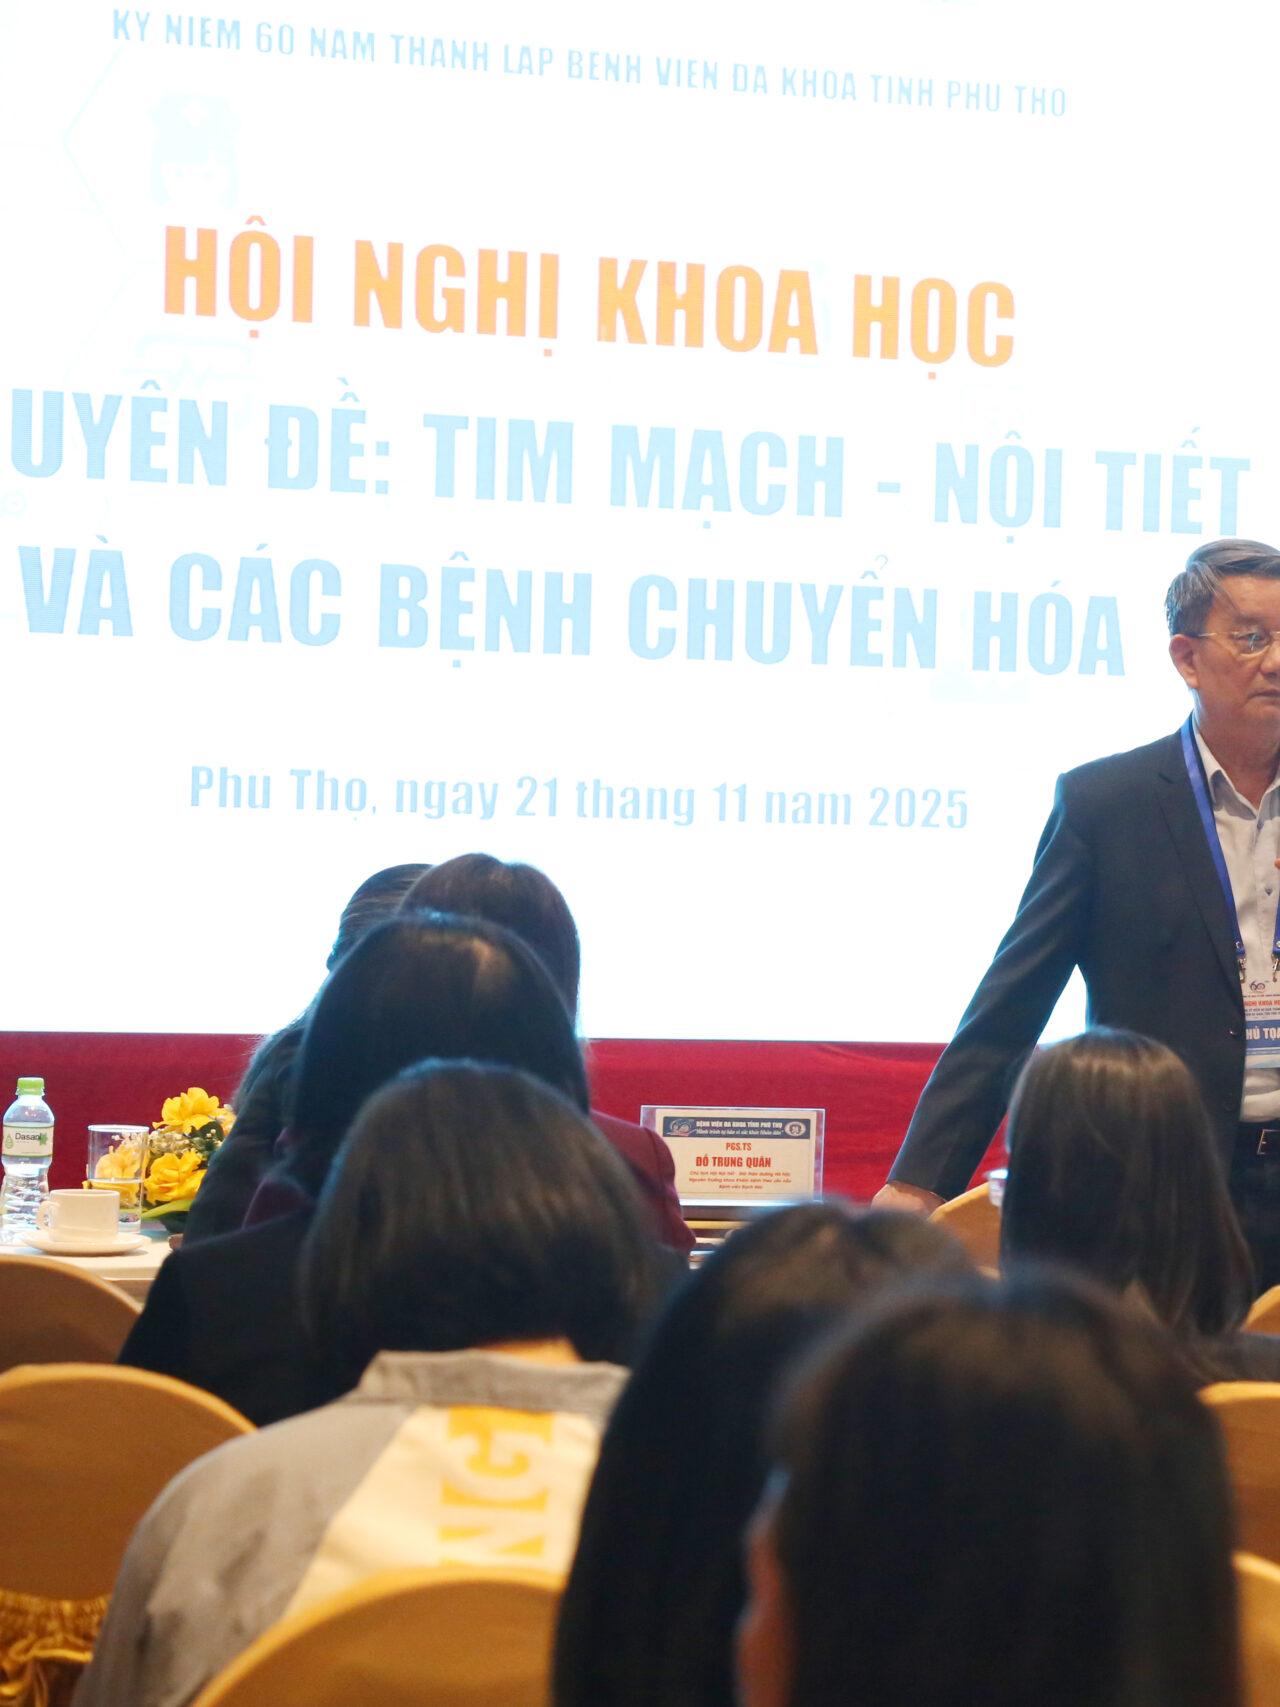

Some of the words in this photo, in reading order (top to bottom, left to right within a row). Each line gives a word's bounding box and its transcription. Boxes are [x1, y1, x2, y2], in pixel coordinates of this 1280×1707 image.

[256, 22, 294, 55] 60
[782, 67, 856, 101] KHOA
[165, 216, 313, 338] HỘI
[354, 240, 558, 356] NGHỊ
[598, 258, 818, 354] KHOA
[853, 275, 1014, 379] HỌC
[11, 380, 228, 486] UYÊN
[264, 378, 389, 494] ĐỀ:
[423, 414, 573, 504] TIM
[610, 424, 844, 529] MẠCH
[878, 482, 900, 493] -
[935, 431, 1063, 544] NỘI
[1095, 427, 1251, 538] TIẾT
[18, 535, 133, 637] VÀ
[169, 543, 341, 646] CÁC
[379, 551, 592, 668] BỆNH
[628, 555, 938, 669] CHUYỂN
[972, 581, 1125, 676] HÓA
[516, 776, 557, 816] 21
[714, 783, 746, 822] 11
[869, 787, 967, 828] 2025
[1246, 1026, 1260, 1040] HỦ
[711, 1156, 743, 1168] TRUNG
[746, 1155, 772, 1168] QUÂN
[726, 1142, 752, 1151] PGS.TS
